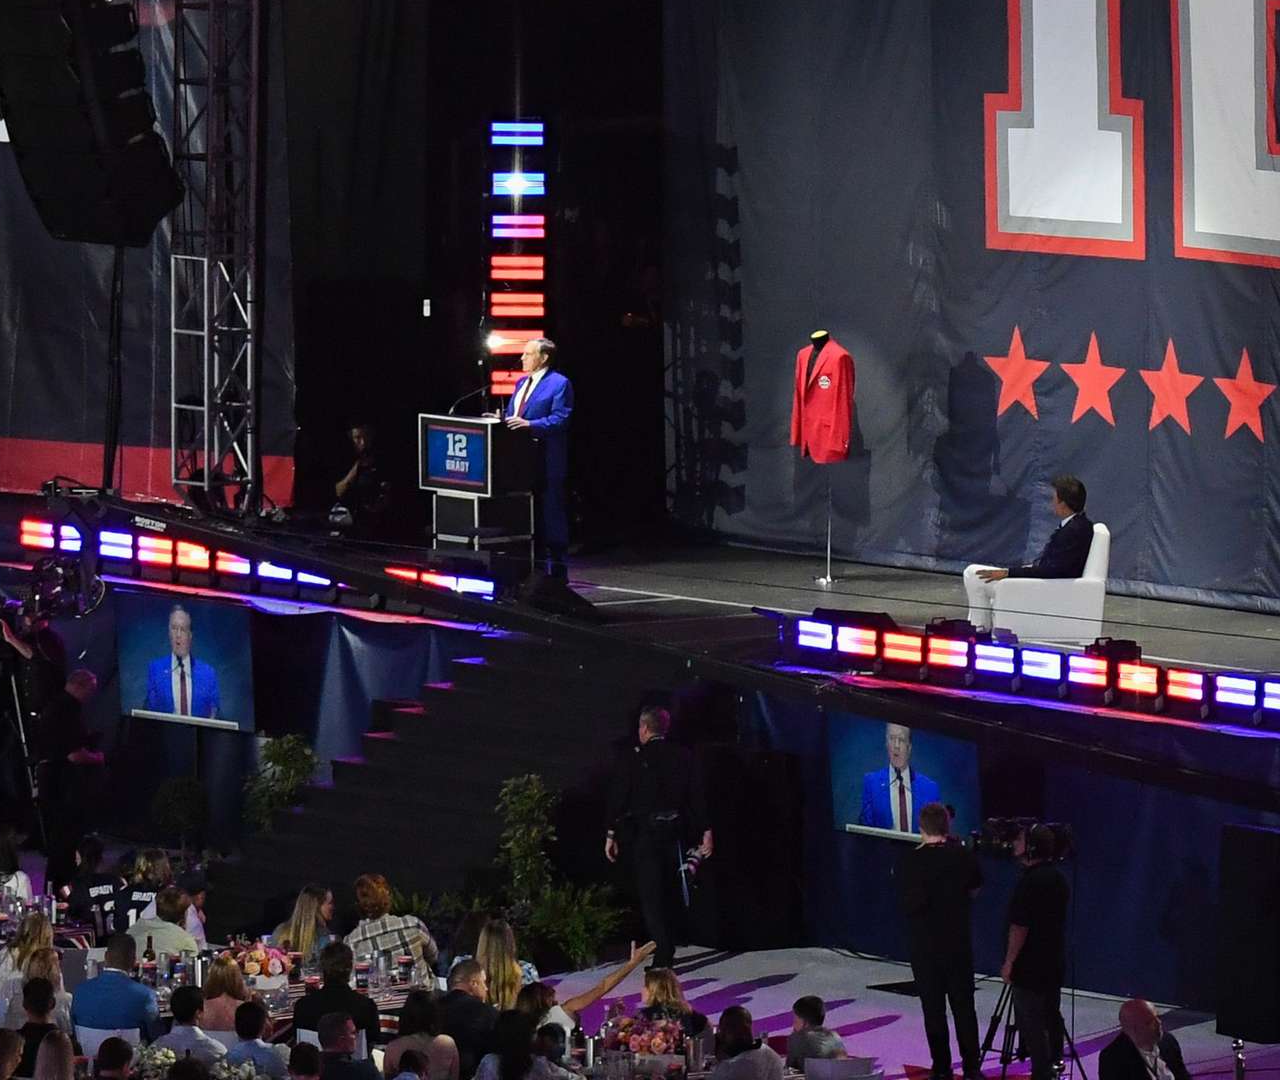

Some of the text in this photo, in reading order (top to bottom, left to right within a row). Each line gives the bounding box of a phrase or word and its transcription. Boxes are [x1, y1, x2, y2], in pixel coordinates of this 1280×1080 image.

[446, 432, 468, 457] 12
[89, 884, 114, 898] BRADY
[131, 891, 157, 902] BRADY
